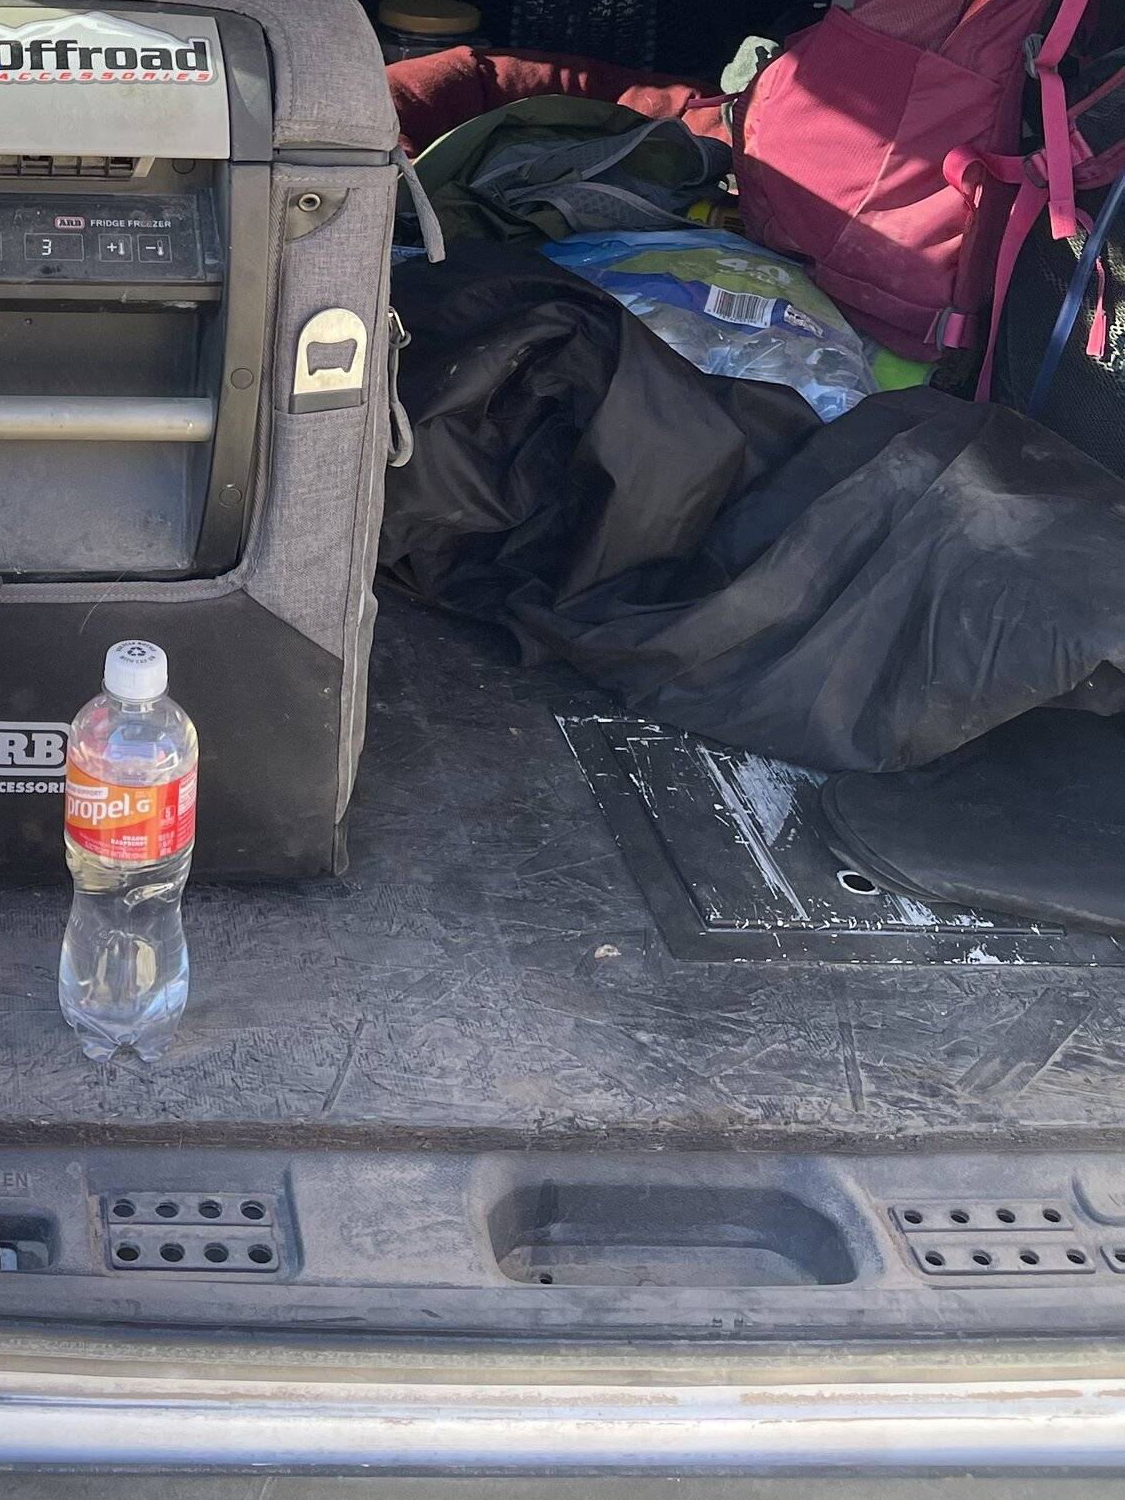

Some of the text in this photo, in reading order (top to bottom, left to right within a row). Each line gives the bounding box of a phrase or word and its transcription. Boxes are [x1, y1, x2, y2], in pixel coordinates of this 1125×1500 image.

[90, 219, 125, 227] FRIDGE
[127, 219, 172, 228] FREEZER
[41, 239, 52, 256] 3
[67, 793, 130, 825] propel
